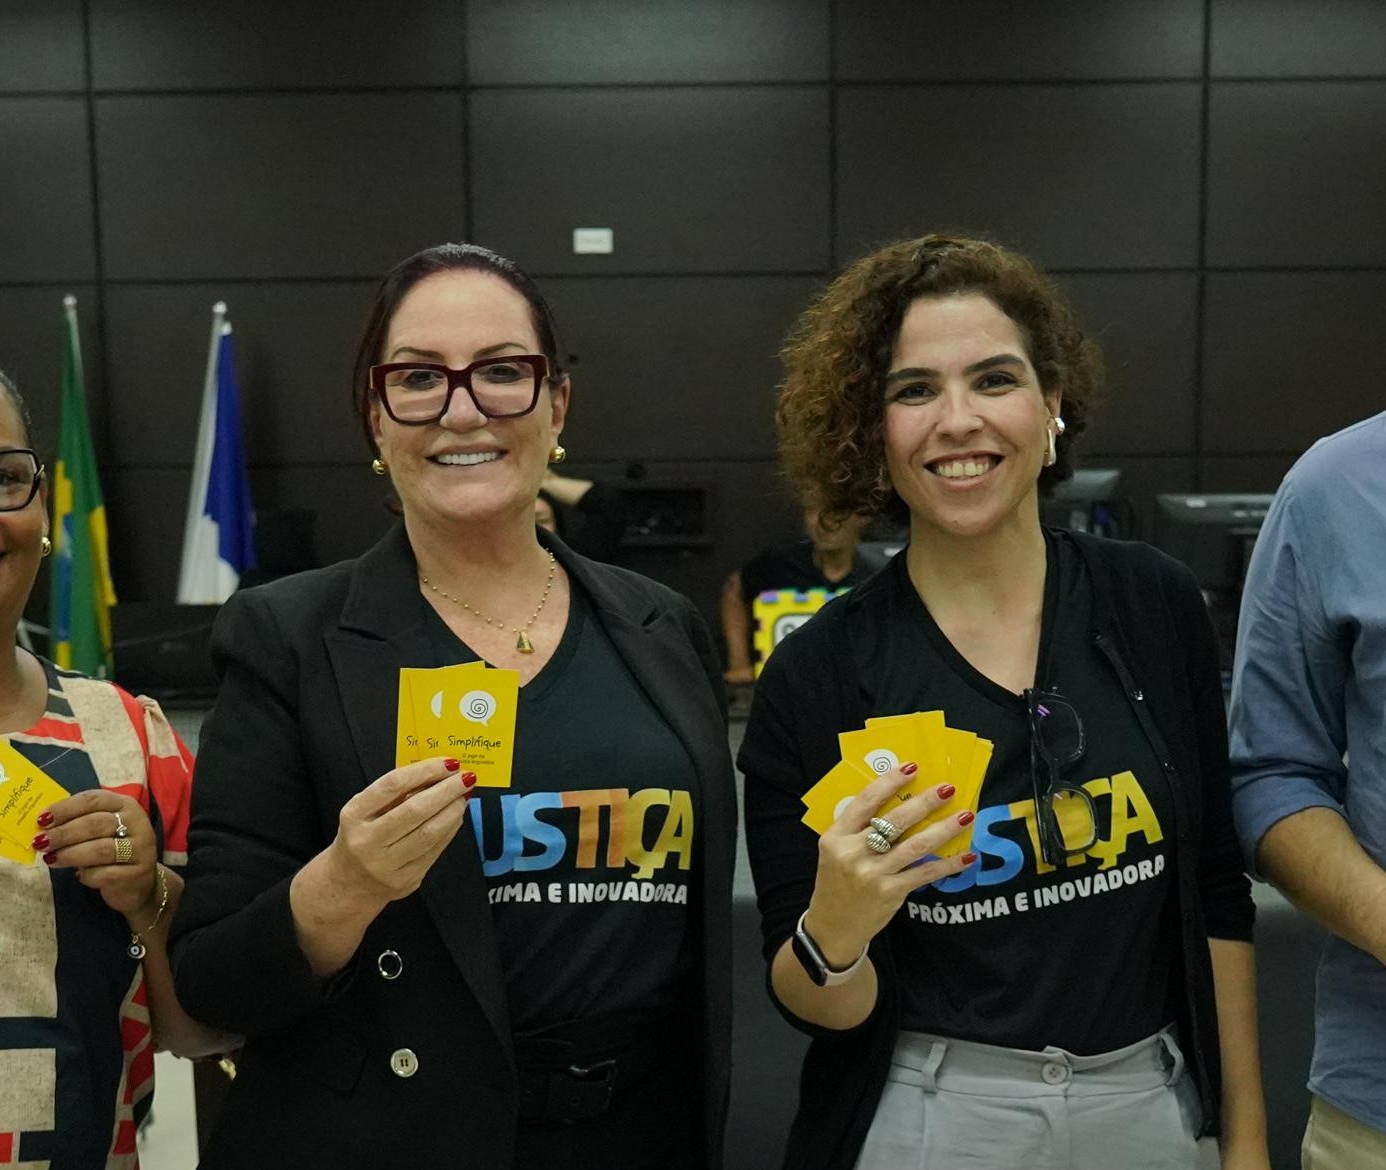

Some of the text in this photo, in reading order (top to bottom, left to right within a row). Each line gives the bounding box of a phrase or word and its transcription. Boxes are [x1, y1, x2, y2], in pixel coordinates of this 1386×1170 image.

[447, 735, 502, 751] Simplifique
[469, 787, 694, 880] USTIÇA
[548, 883, 562, 903] E
[568, 881, 688, 904] INOVADORA
[908, 854, 1165, 925] PRÓXIMA E INOVADORA
